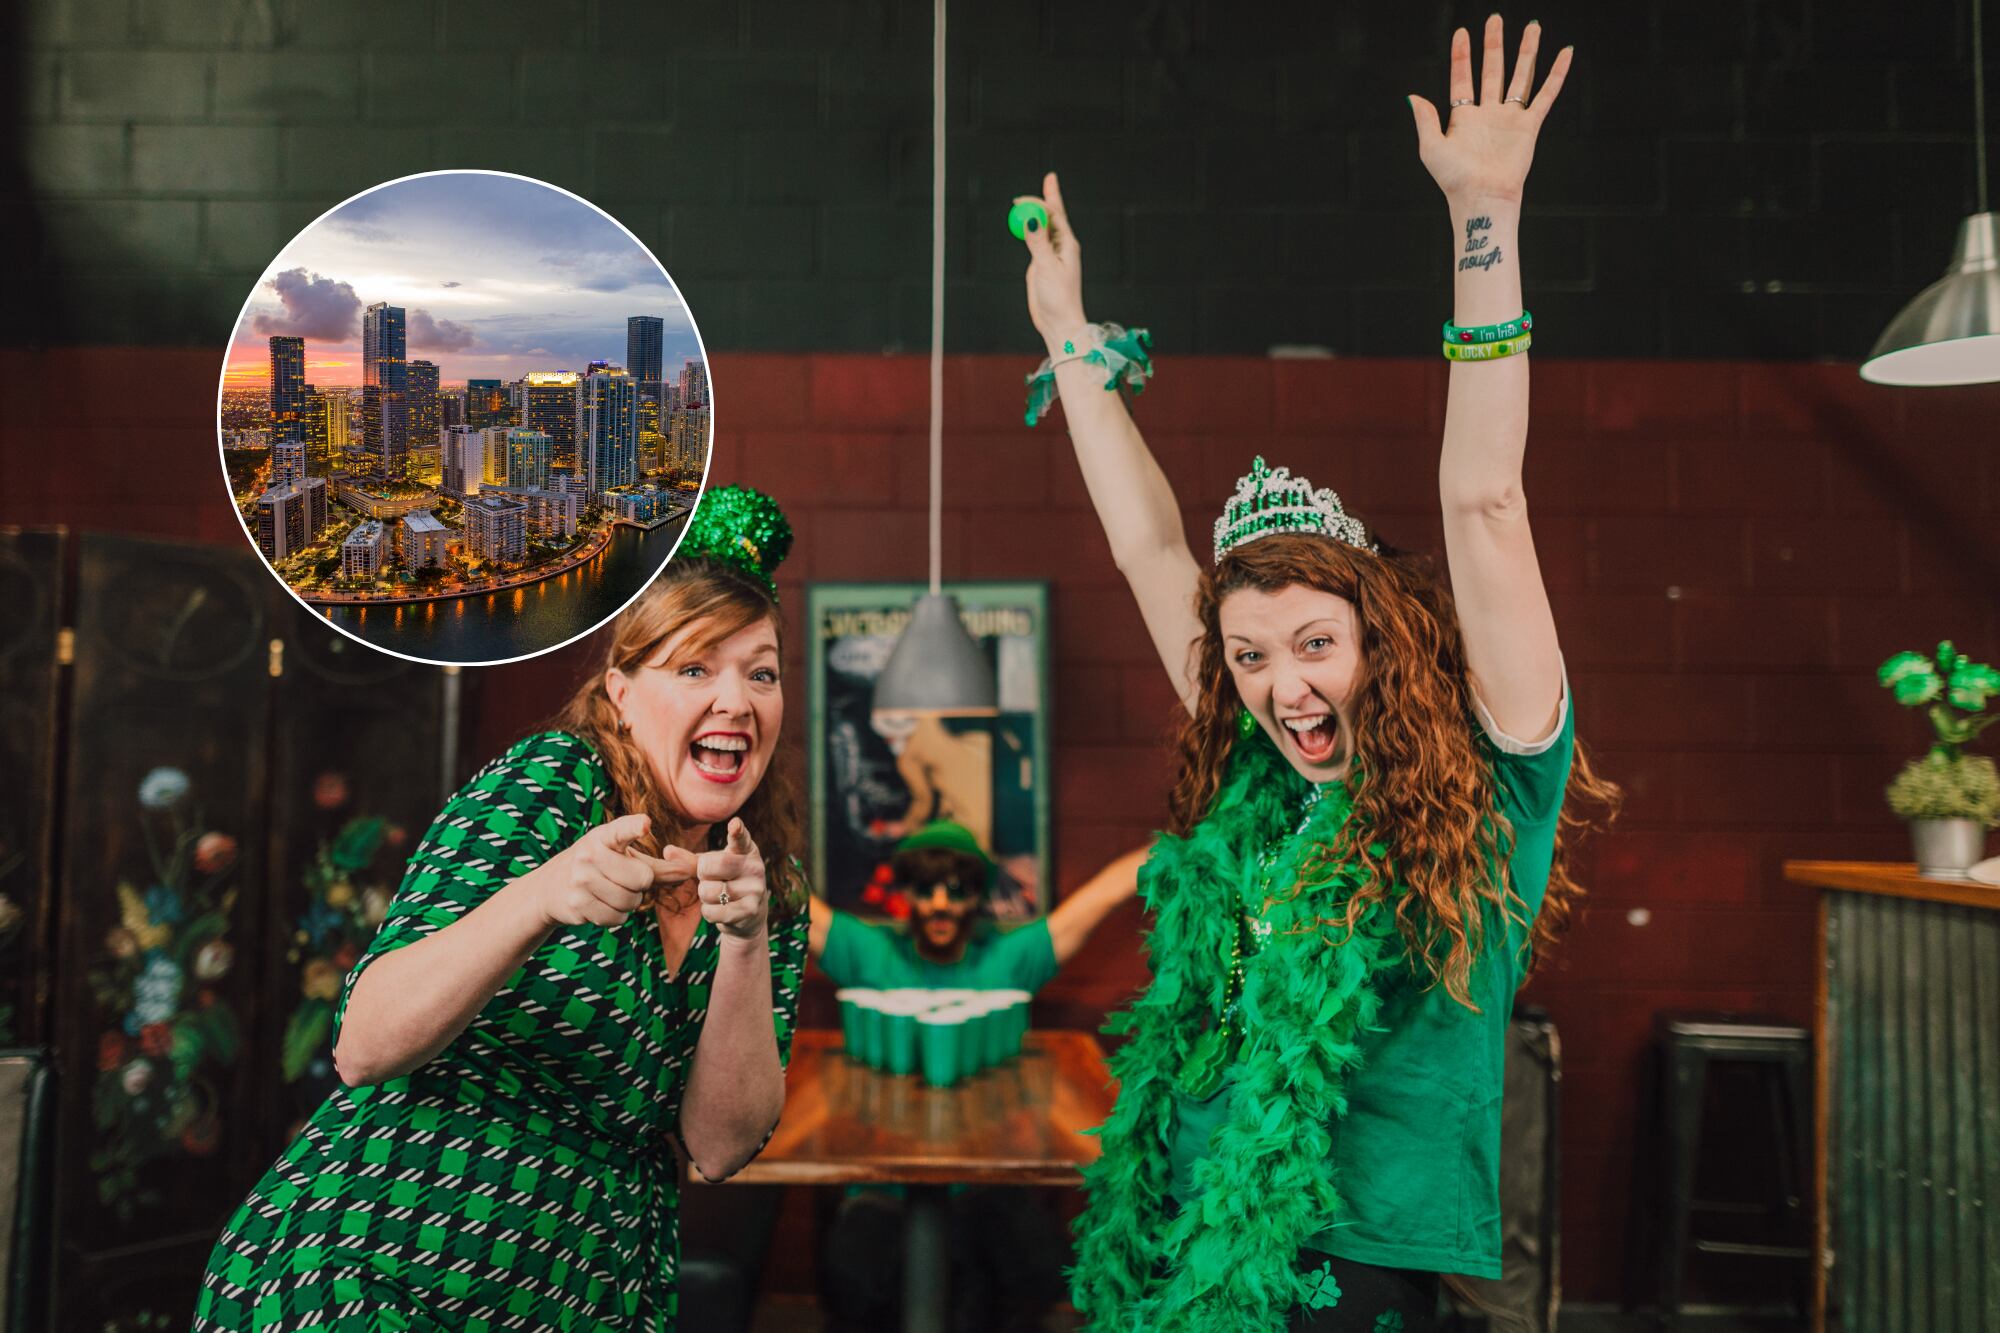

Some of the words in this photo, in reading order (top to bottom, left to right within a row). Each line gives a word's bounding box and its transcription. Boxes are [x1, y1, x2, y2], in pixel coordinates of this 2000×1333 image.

[1466, 216, 1492, 238] you
[1465, 236, 1488, 252] are
[1480, 329, 1495, 342] I'm
[1497, 324, 1518, 340] Irish
[1460, 343, 1492, 359] LUCKY
[1229, 490, 1304, 526] IRISH
